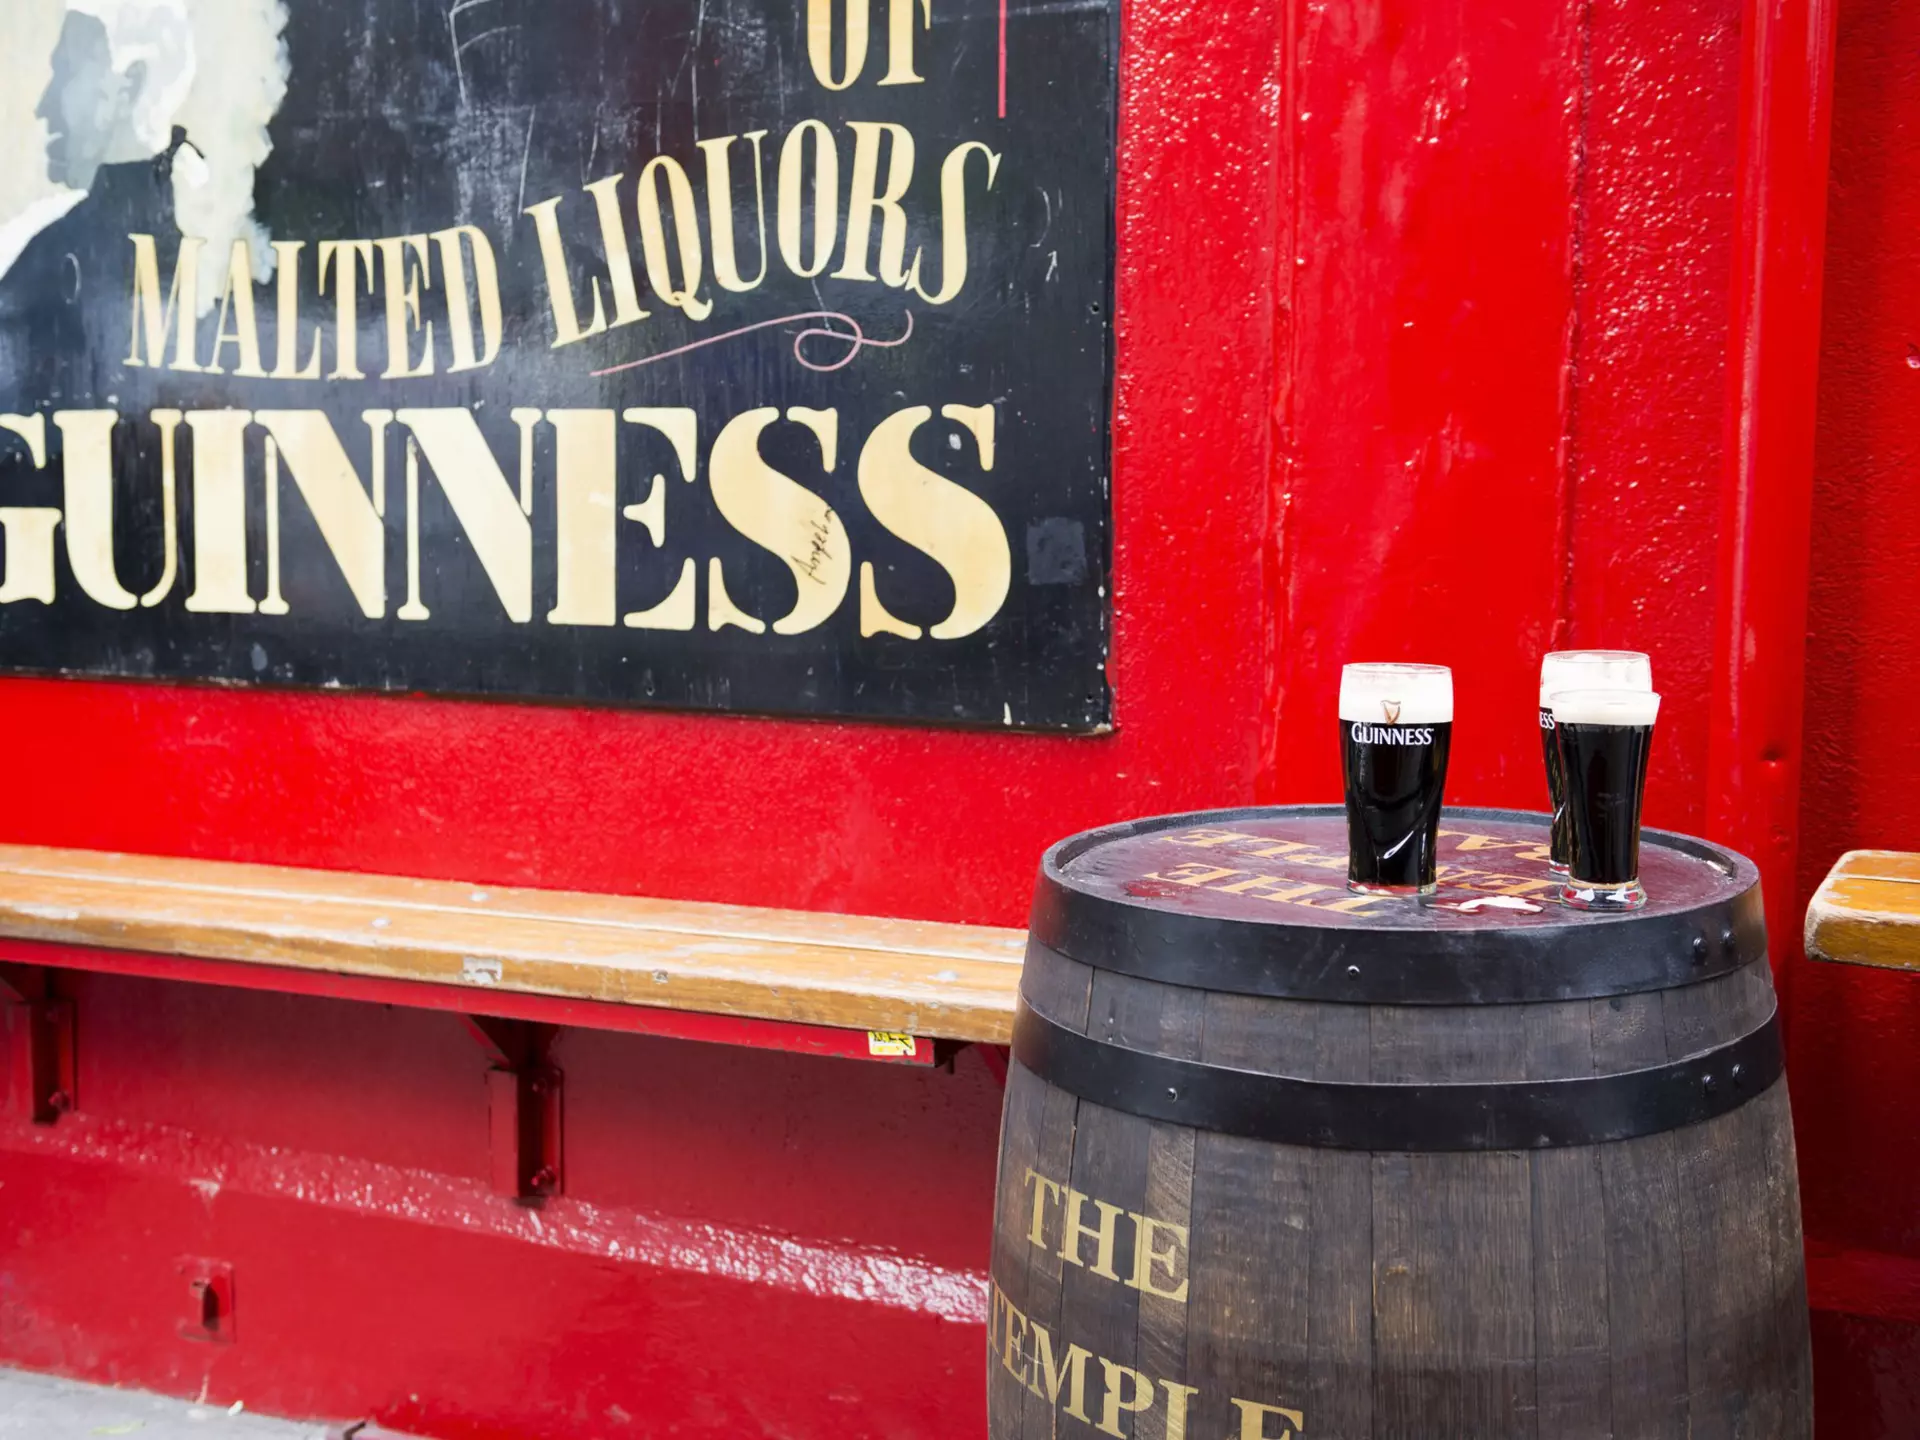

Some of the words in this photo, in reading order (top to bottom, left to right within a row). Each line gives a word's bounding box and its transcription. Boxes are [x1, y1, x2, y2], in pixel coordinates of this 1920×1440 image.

[122, 224, 502, 380] MALTED
[523, 119, 1001, 348] LIQUORS
[1351, 722, 1434, 746] GUINNESS
[1024, 1168, 1189, 1303] THE
